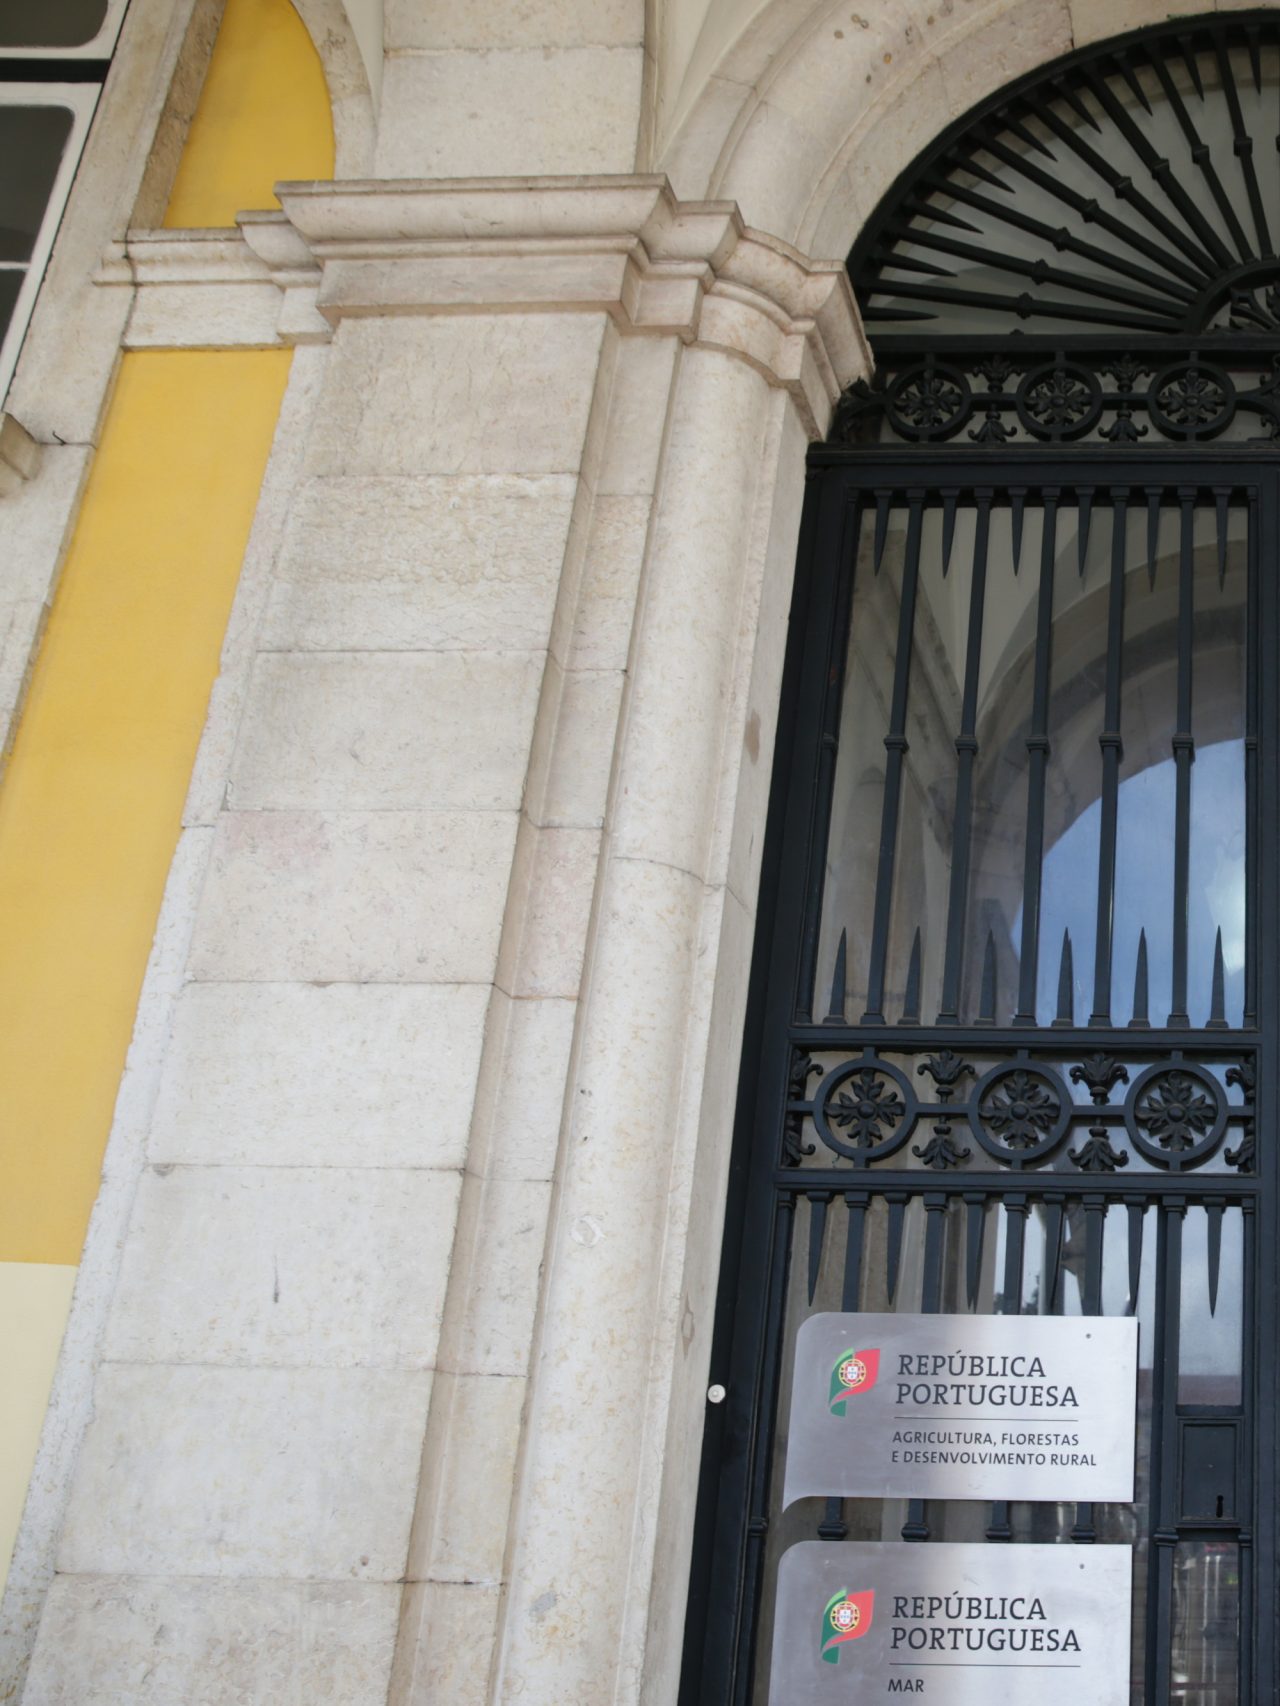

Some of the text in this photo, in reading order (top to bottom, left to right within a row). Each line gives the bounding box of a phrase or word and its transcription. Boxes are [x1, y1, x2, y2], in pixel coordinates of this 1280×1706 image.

[897, 1349, 1047, 1378] REPÚBLICA
[895, 1382, 1080, 1408] PORTUGUESA
[892, 1431, 1080, 1448] AGRICULTURA, FLORESTAS
[891, 1450, 1097, 1467] E DESENVOLVIMENTO RURAL
[891, 1590, 1048, 1621] REPÚBLICA
[889, 1627, 1082, 1652] PORTUGUESA
[887, 1678, 925, 1693] MAR
